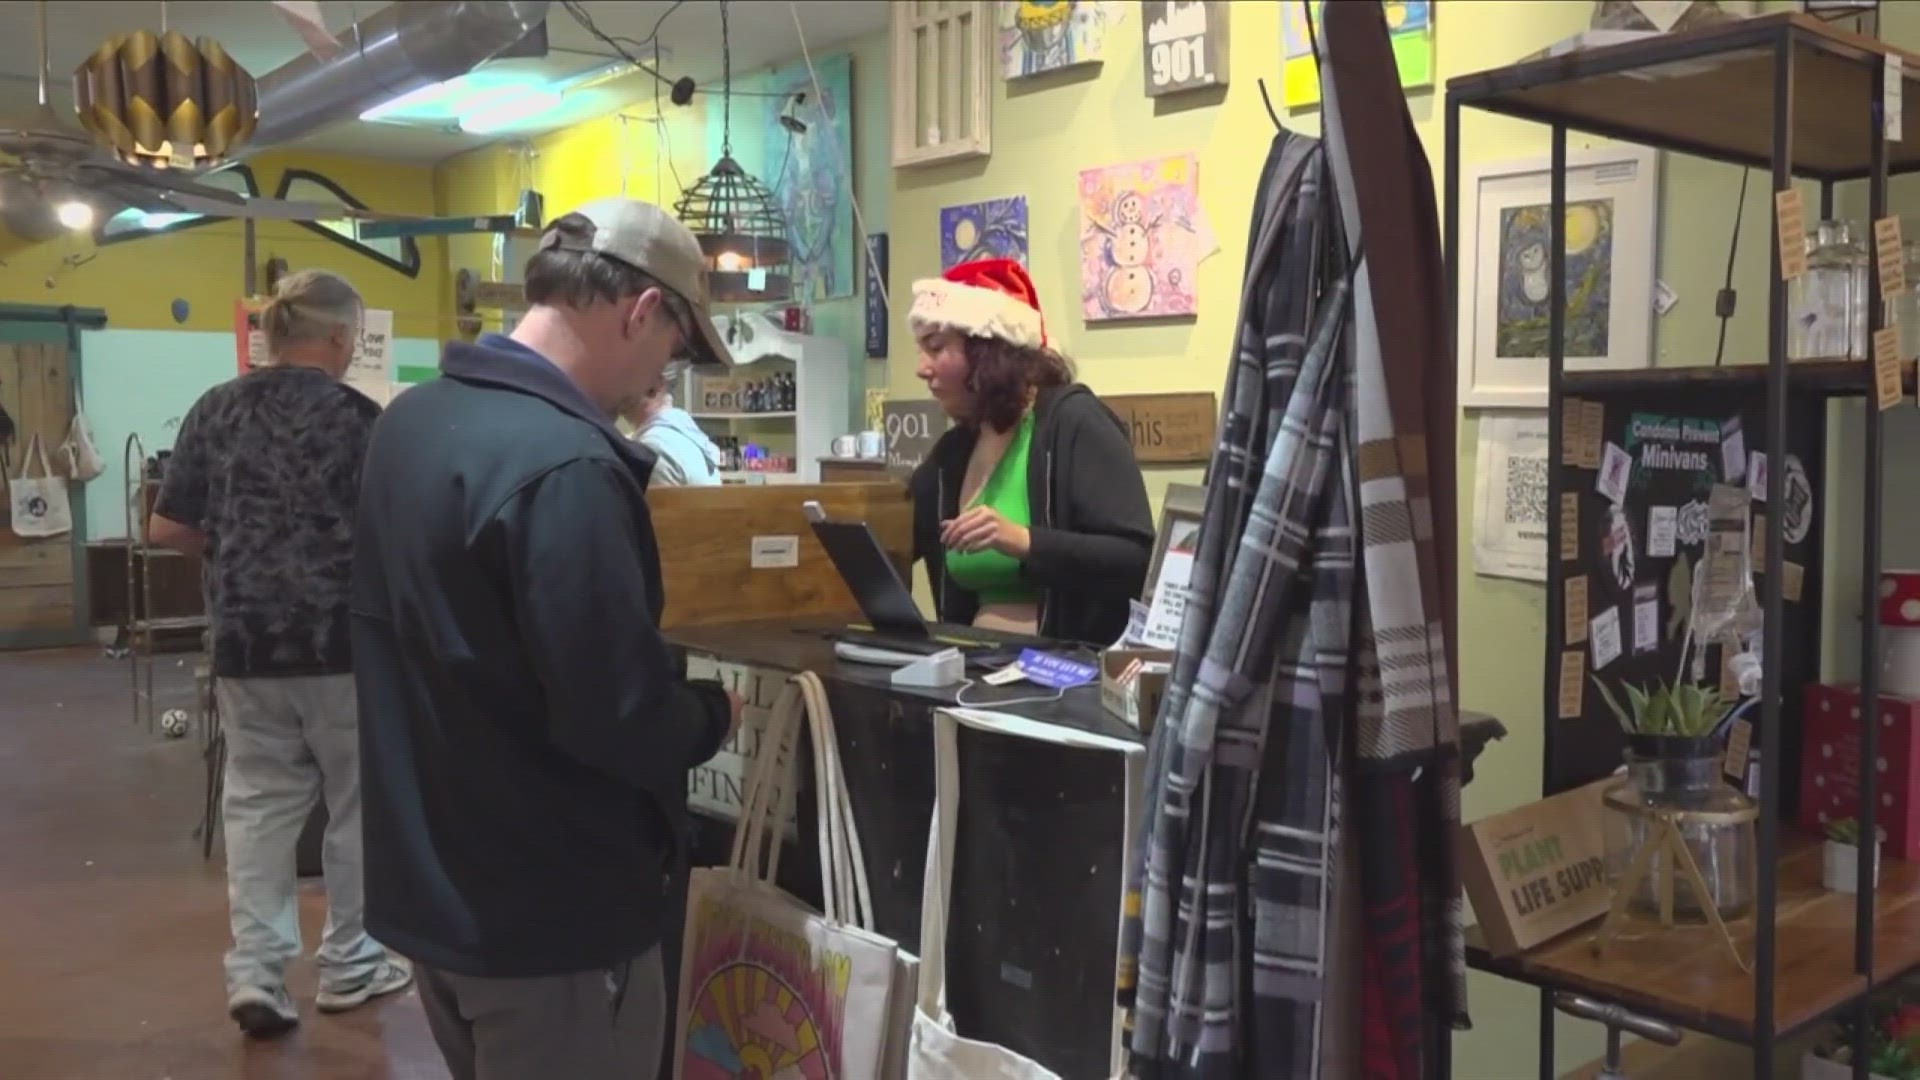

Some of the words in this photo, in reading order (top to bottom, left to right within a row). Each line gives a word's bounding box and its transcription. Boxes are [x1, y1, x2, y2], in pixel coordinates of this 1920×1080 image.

[1151, 33, 1215, 86] 901.
[885, 412, 930, 449] 901
[1124, 409, 1163, 449] his
[1641, 443, 1708, 471] Minivans
[1518, 530, 1549, 540] venm
[1499, 834, 1564, 881] PLANT
[1511, 876, 1556, 917] LIFE
[1555, 855, 1604, 898] SUPP
